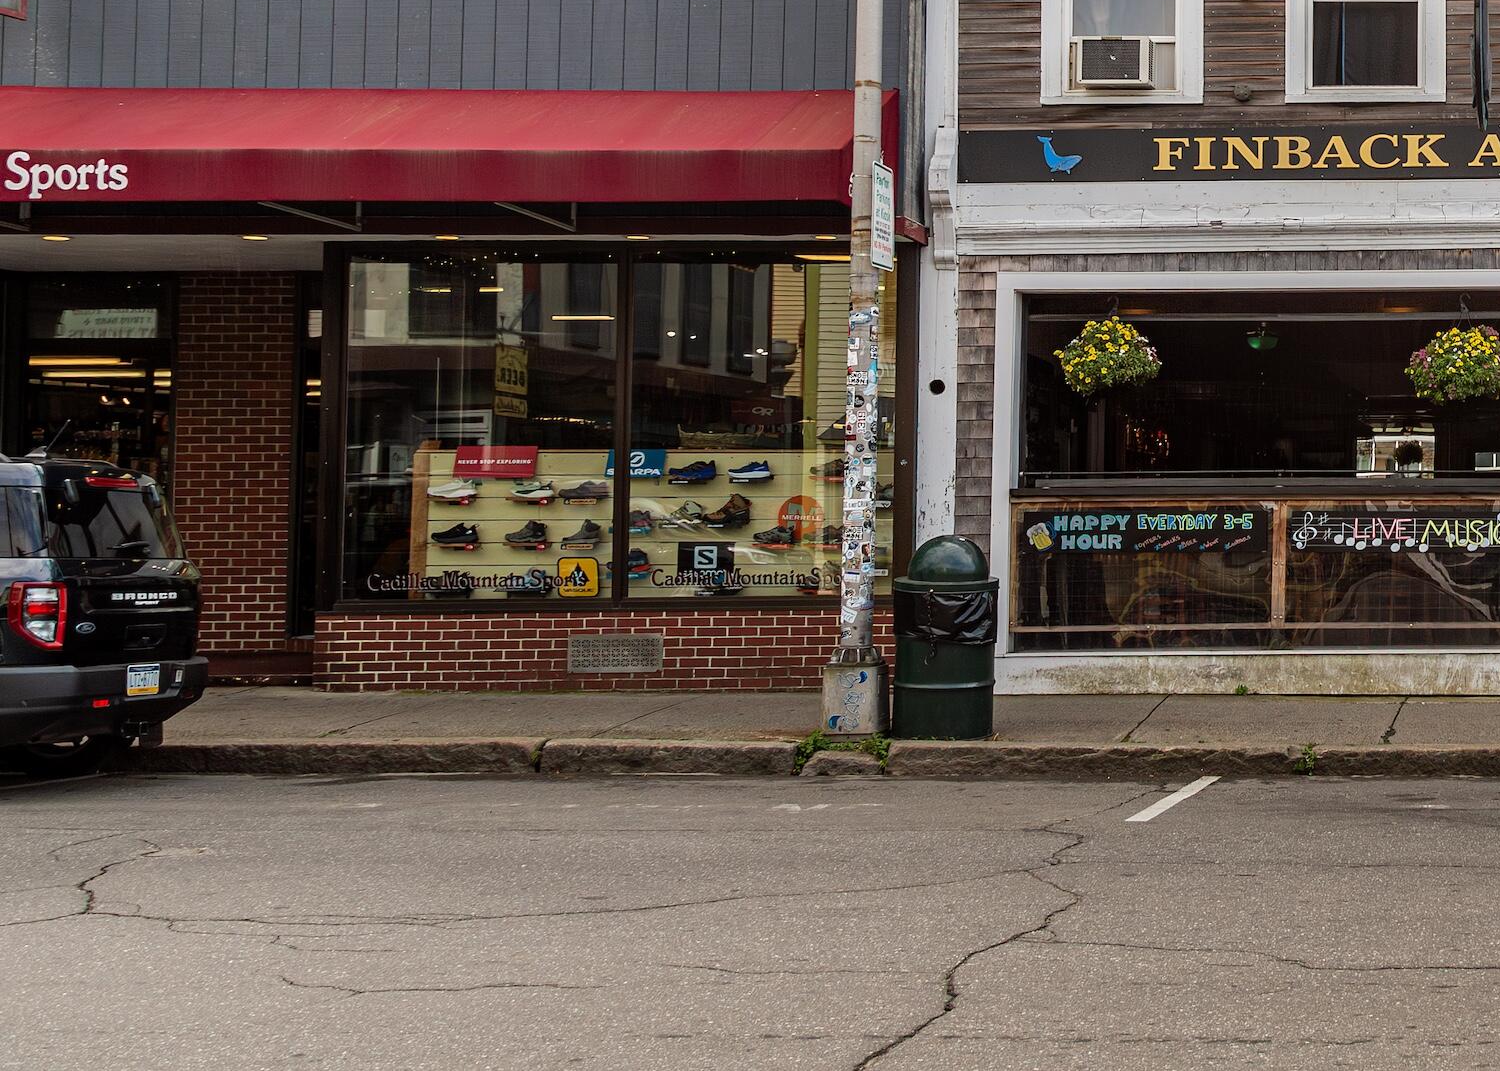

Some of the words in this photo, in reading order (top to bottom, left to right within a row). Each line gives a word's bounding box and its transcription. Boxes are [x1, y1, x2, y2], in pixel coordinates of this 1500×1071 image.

[1152, 133, 1451, 170] FINBACK
[4, 151, 129, 199] Sports
[606, 468, 661, 476] SARPA
[1053, 514, 1131, 532] HAPPY
[1137, 513, 1218, 532] EVERYDAY
[1223, 513, 1254, 530] 3-5
[1353, 518, 1412, 539] LIVE
[1061, 533, 1124, 550] HOUR
[367, 571, 439, 591] Cadillac
[441, 570, 524, 590] Mountain
[528, 569, 587, 593] Sports
[723, 566, 806, 587] Mountain
[811, 566, 842, 587] Spo
[111, 592, 178, 601] BRONCO
